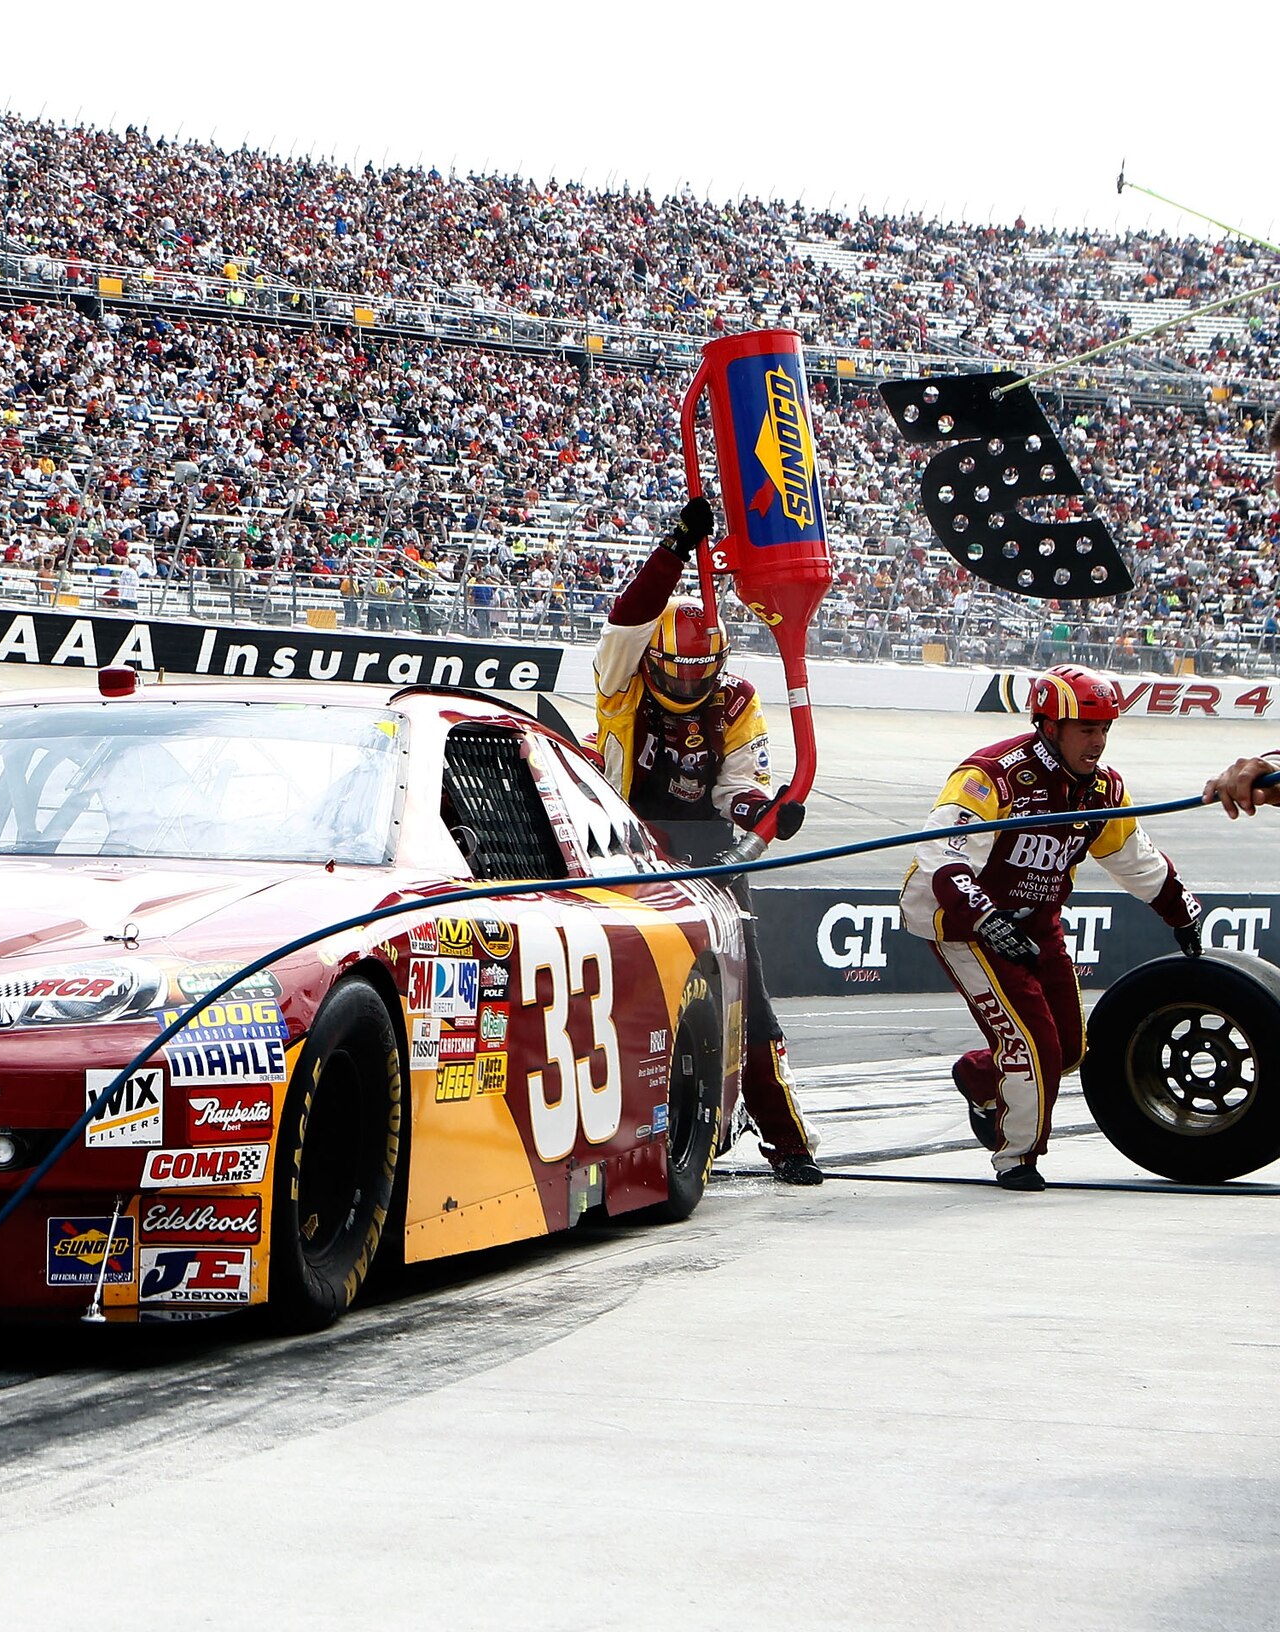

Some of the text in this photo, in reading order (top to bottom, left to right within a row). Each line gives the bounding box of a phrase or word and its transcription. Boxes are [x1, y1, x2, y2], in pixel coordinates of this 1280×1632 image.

[771, 373, 813, 521] SUNOCO
[195, 628, 540, 691] Insurance
[673, 655, 716, 664] SIMPSON
[998, 748, 1027, 769] BB&T
[1033, 741, 1060, 771] BB&T
[1005, 834, 1085, 871] BB&T
[483, 920, 500, 937] Sprint
[816, 902, 901, 969] GT
[31, 978, 116, 998] RCR
[409, 960, 433, 1010] 3M
[458, 962, 477, 1010] USG
[843, 969, 881, 983] VODKA
[483, 988, 505, 997] POLE
[163, 1001, 278, 1031] MOOG
[242, 1025, 281, 1039] PARTS
[440, 1037, 476, 1055] CRAFTSMAN
[518, 905, 622, 1163] 33
[970, 987, 1035, 1083] BB&T
[166, 1041, 285, 1077] MAHLE
[412, 1040, 439, 1058] TISSOT
[484, 1057, 502, 1072] Auto
[436, 1063, 475, 1102] JEGS
[483, 1073, 504, 1090] Meter
[87, 1072, 160, 1121] WIX
[88, 1117, 161, 1145] FILTERS
[150, 1151, 240, 1180] COMP
[212, 1170, 253, 1183] CAMS
[142, 1205, 258, 1233] Edelbrock
[141, 1250, 245, 1298] JE
[171, 1291, 249, 1301] PISTONS
